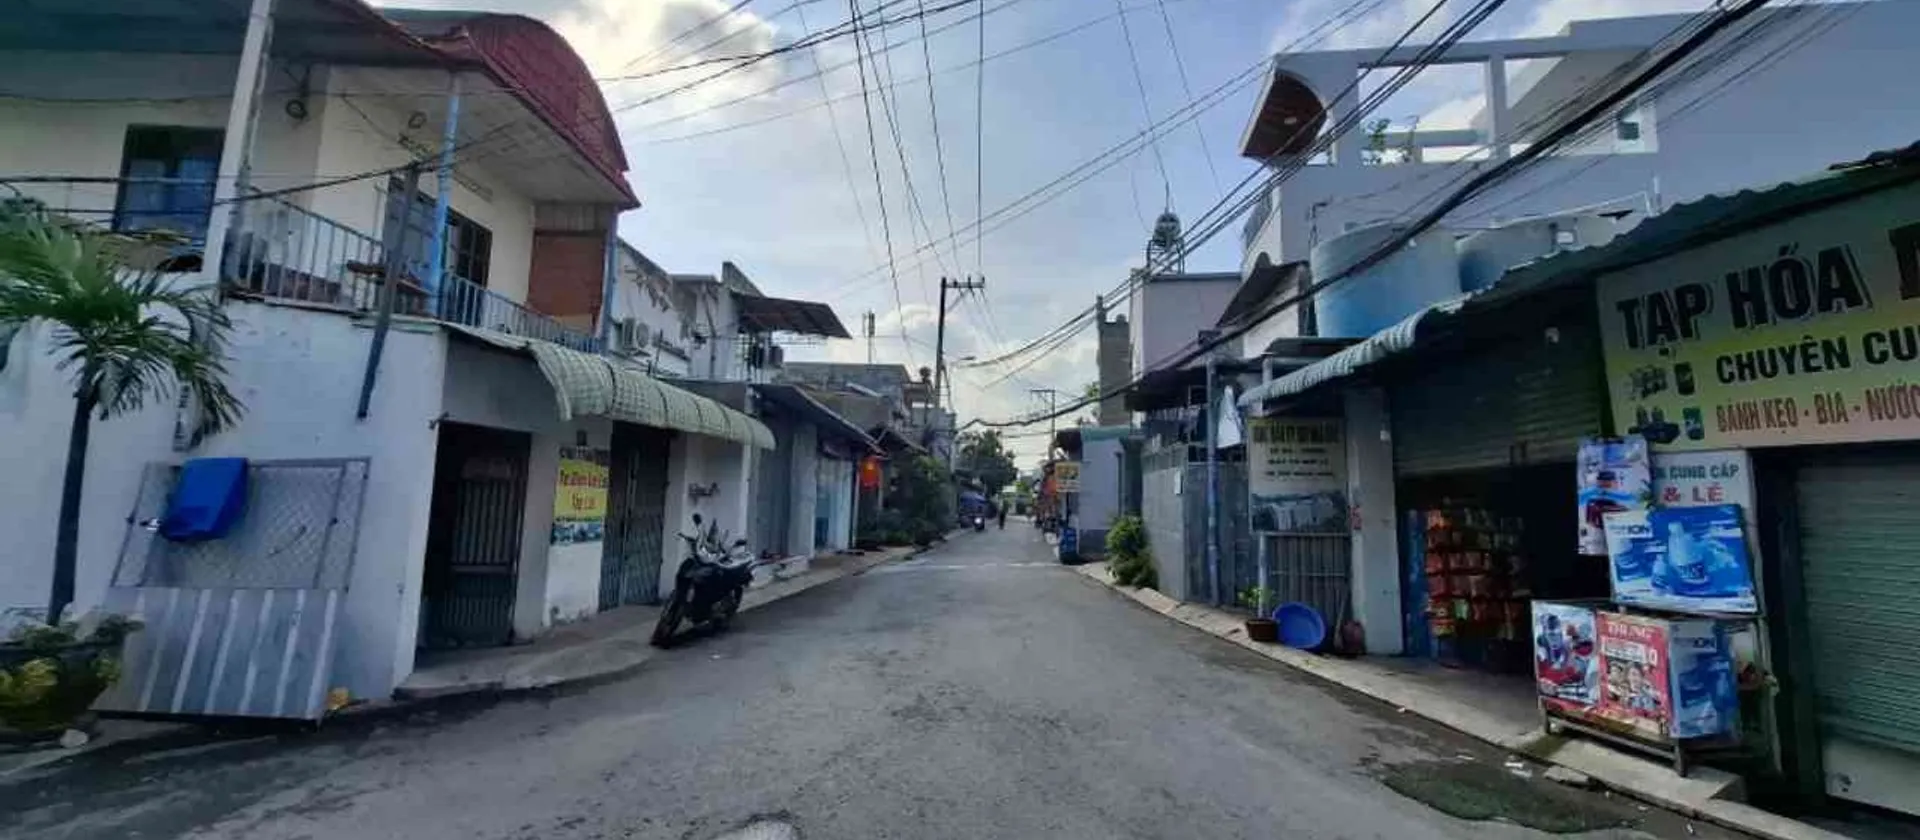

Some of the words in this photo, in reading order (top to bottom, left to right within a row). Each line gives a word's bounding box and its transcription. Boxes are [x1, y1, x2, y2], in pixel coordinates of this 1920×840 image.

[1615, 283, 1711, 356] TẠP
[1725, 242, 1869, 329] HÓA
[1716, 335, 1851, 384] CHUYÊN
[1862, 325, 1920, 365] CU
[1715, 399, 1761, 432] BÁNH
[1762, 397, 1799, 434] KẸO
[1814, 391, 1849, 424] BIA
